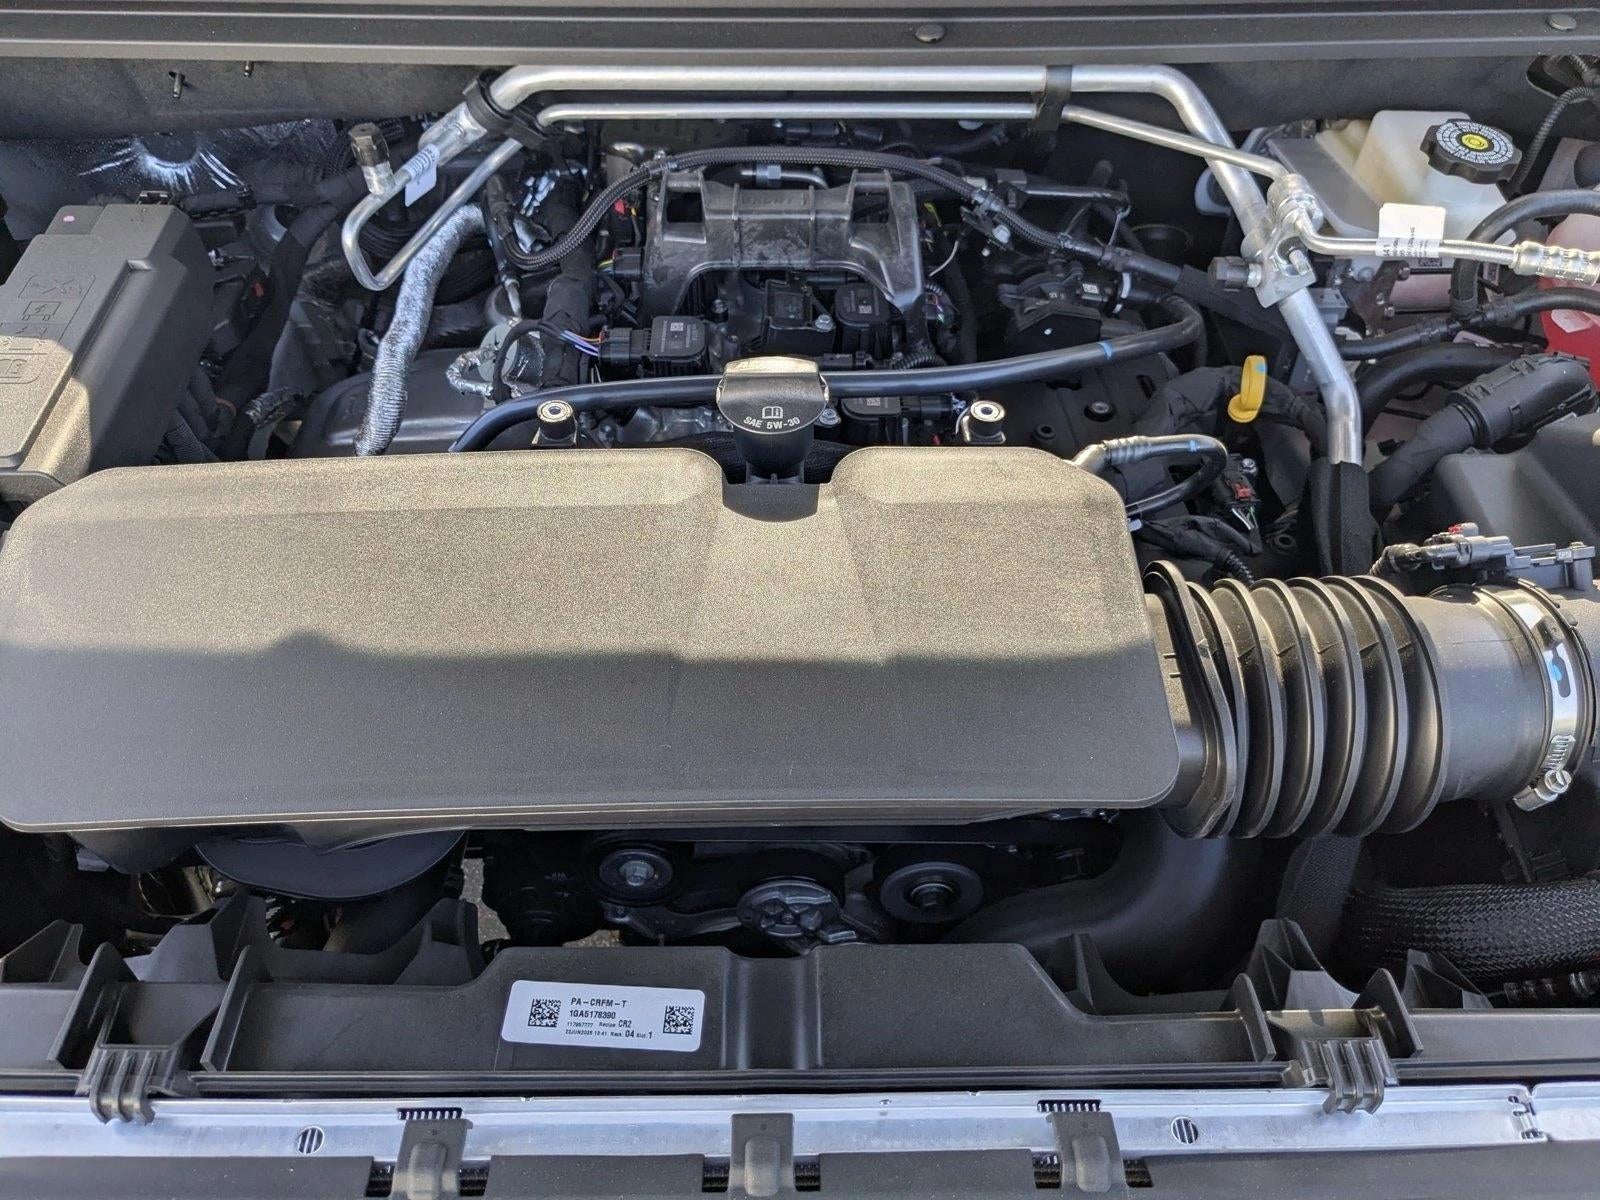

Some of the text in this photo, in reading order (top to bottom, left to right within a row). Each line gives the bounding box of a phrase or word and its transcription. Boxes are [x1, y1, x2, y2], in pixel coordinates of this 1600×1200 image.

[743, 416, 801, 430] SAE 5W-30
[569, 1009, 617, 1020] 1GA5178390
[618, 1019, 632, 1029] CR2
[625, 1029, 635, 1039] 04
[648, 1030, 653, 1040] 1
